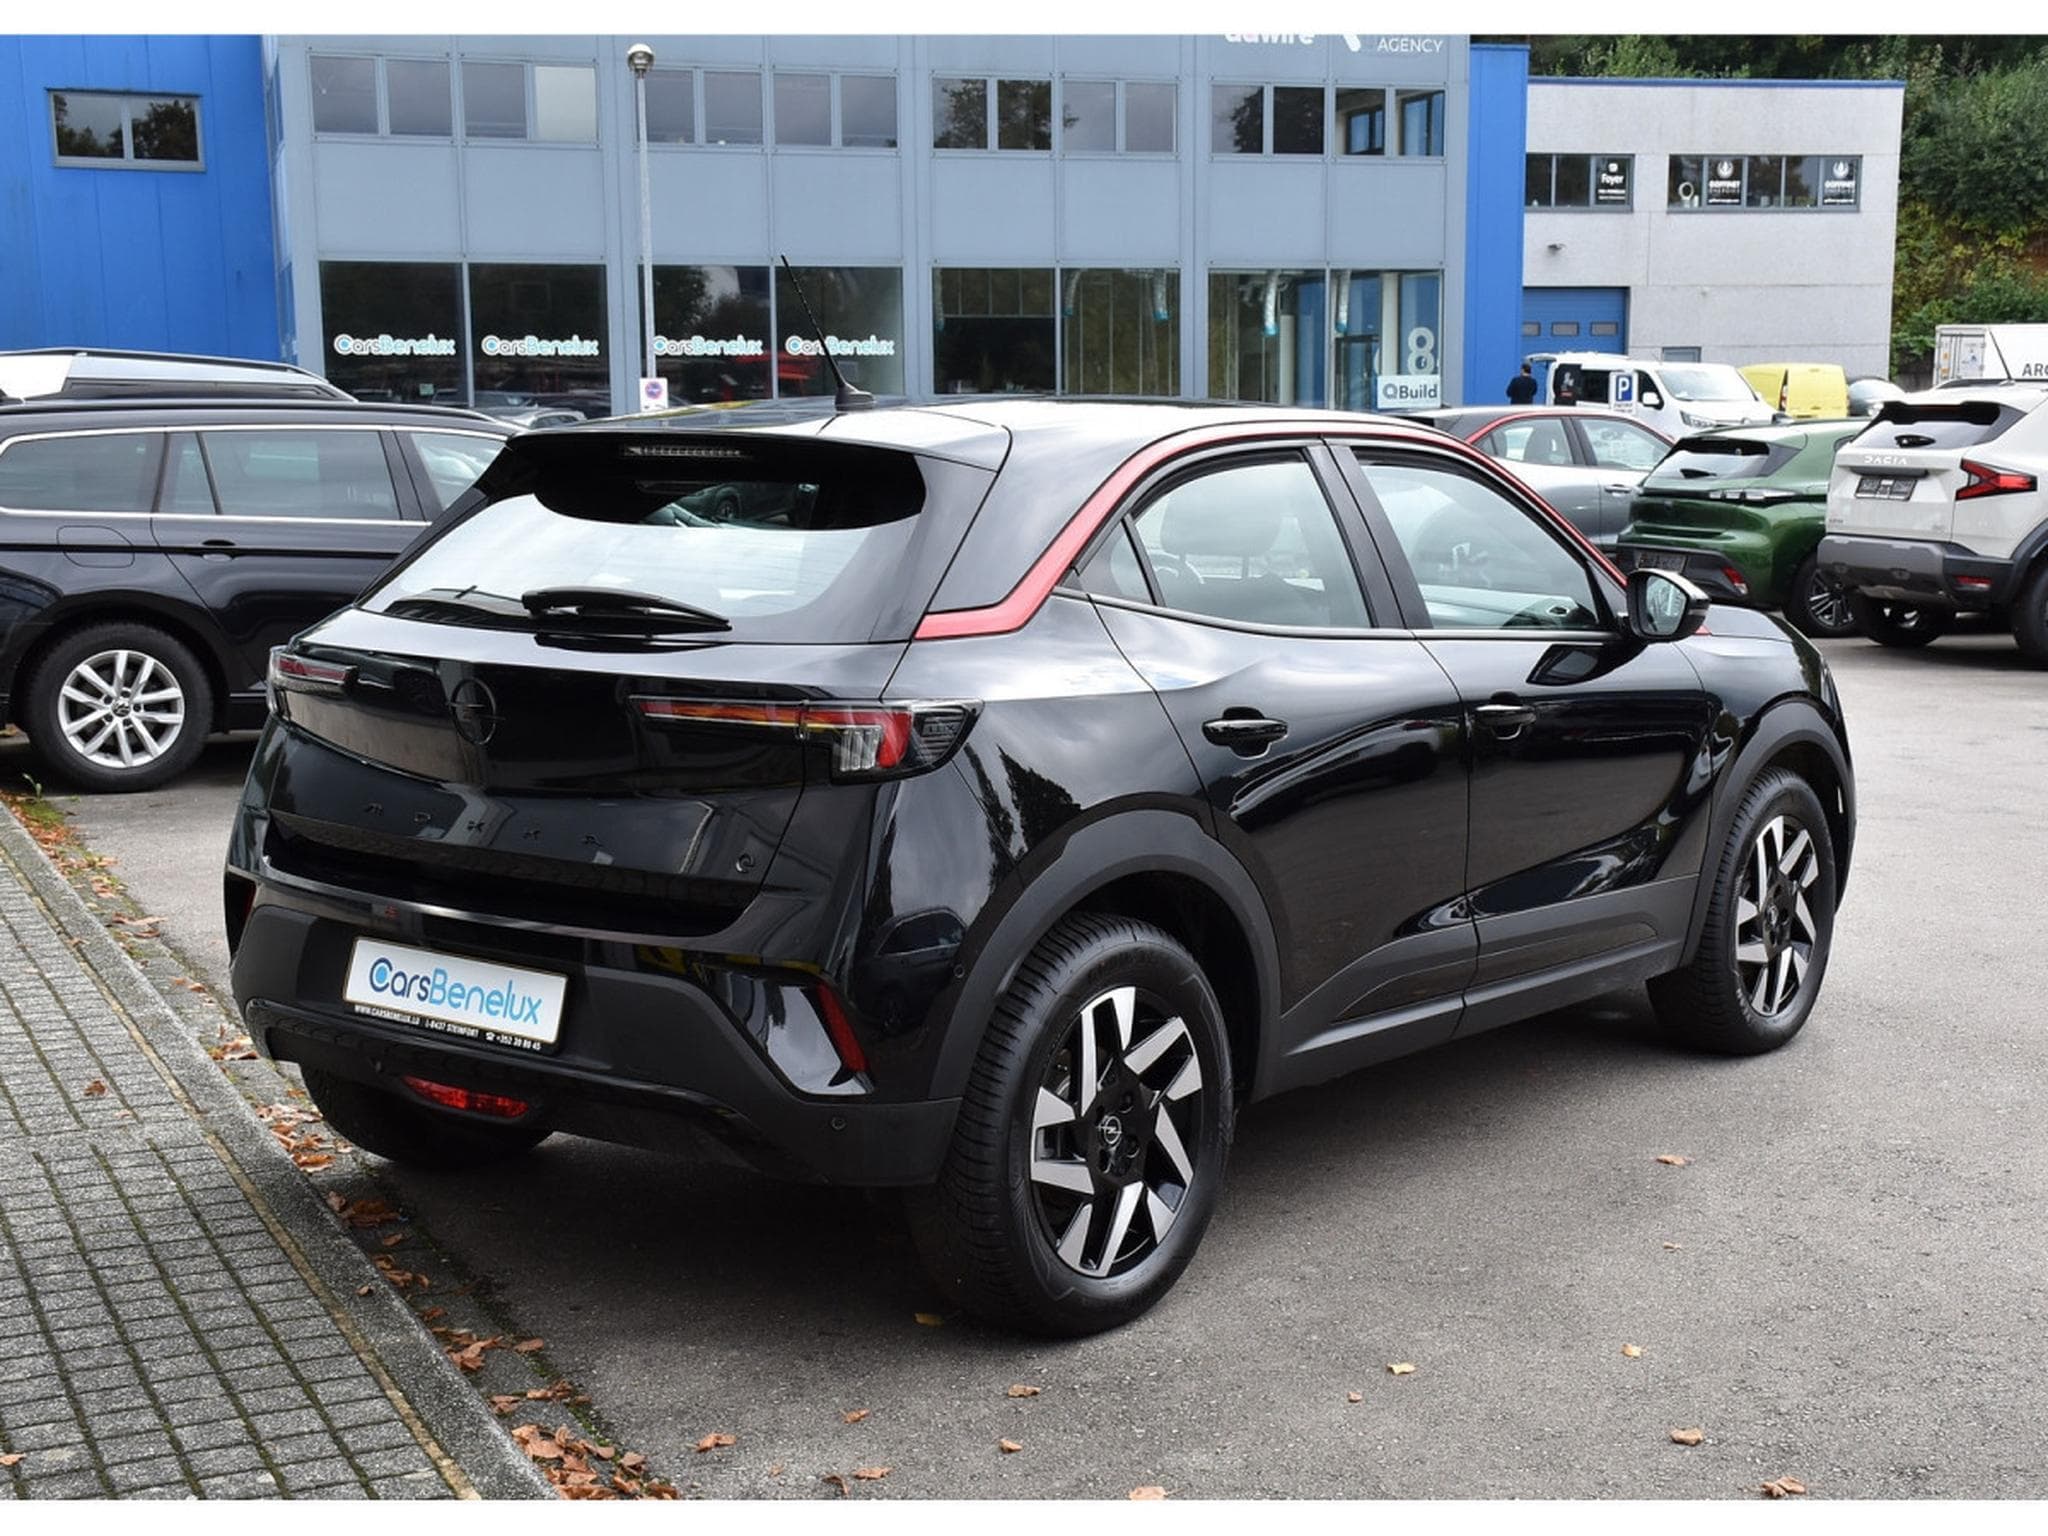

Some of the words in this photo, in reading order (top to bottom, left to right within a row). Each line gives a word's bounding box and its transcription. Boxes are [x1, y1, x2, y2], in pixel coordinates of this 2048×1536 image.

[1377, 38, 1444, 52] AGENCY
[334, 333, 456, 356] CarsBenelux
[481, 334, 599, 356] CarsBenelux
[653, 334, 763, 356] CarsBenelux
[1383, 383, 1438, 399] QBuild
[1618, 377, 1630, 400] P
[1864, 455, 1908, 465] DACIA
[369, 957, 543, 1025] CarsBenelux
